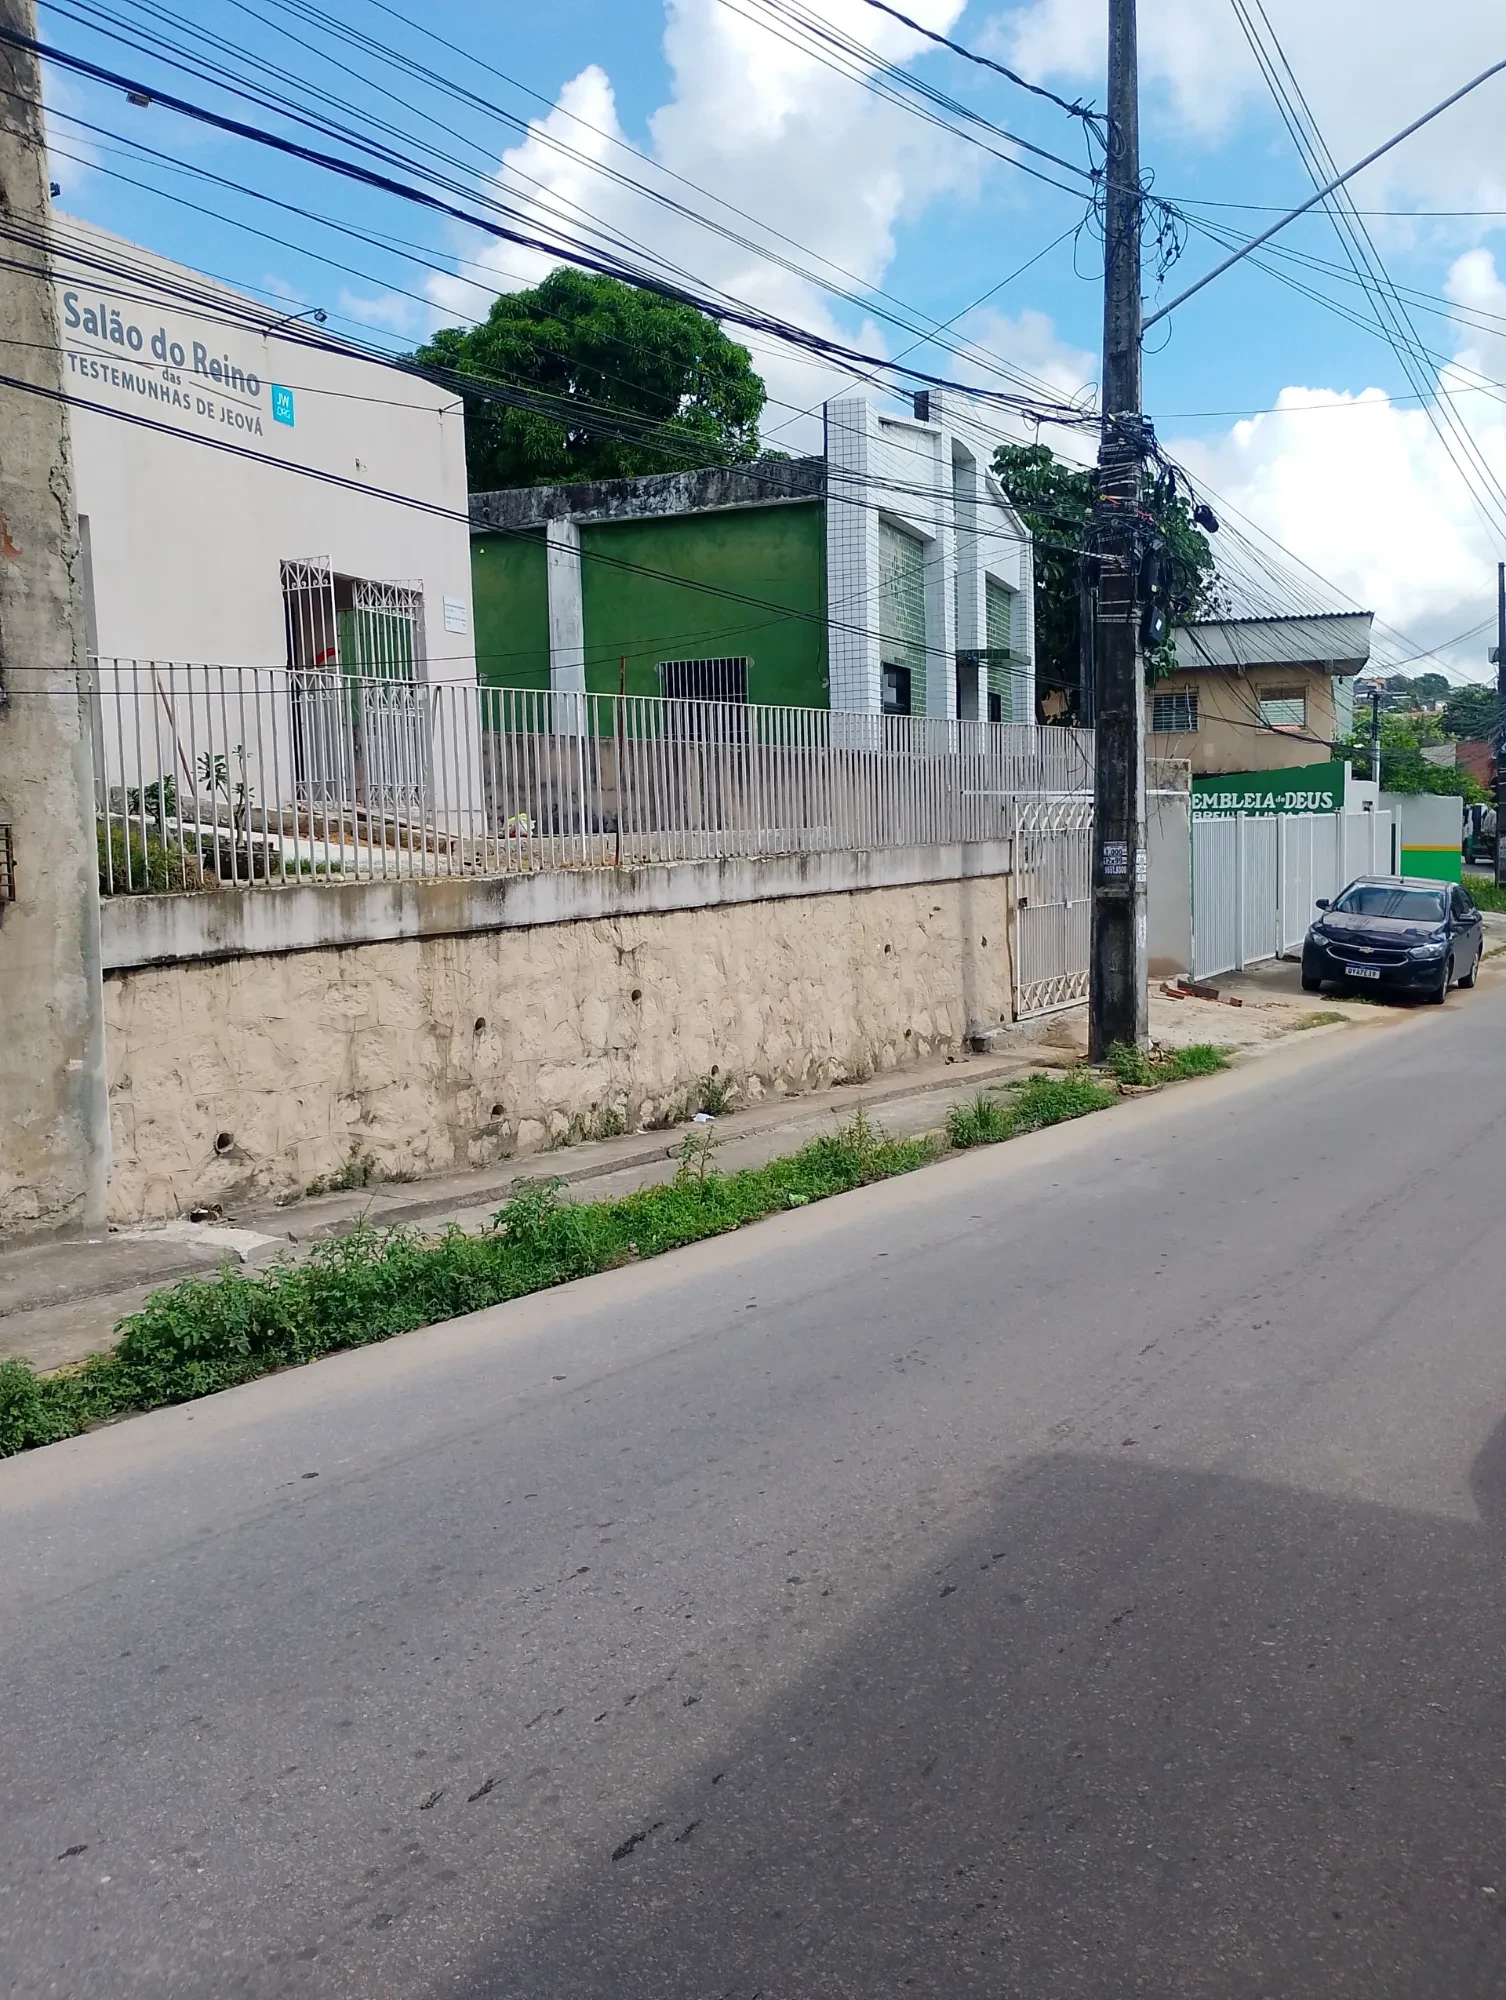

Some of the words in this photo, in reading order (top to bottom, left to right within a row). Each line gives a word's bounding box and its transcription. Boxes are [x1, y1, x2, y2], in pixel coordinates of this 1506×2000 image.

[63, 291, 143, 351] Salão
[151, 327, 185, 367] do
[192, 341, 261, 396] Reino
[162, 367, 182, 386] das
[68, 352, 191, 410] TESTEMUNHAS
[196, 397, 215, 419] DE
[219, 406, 264, 437] JEOVÁ
[276, 392, 290, 408] JW
[1283, 791, 1333, 809] DEUS
